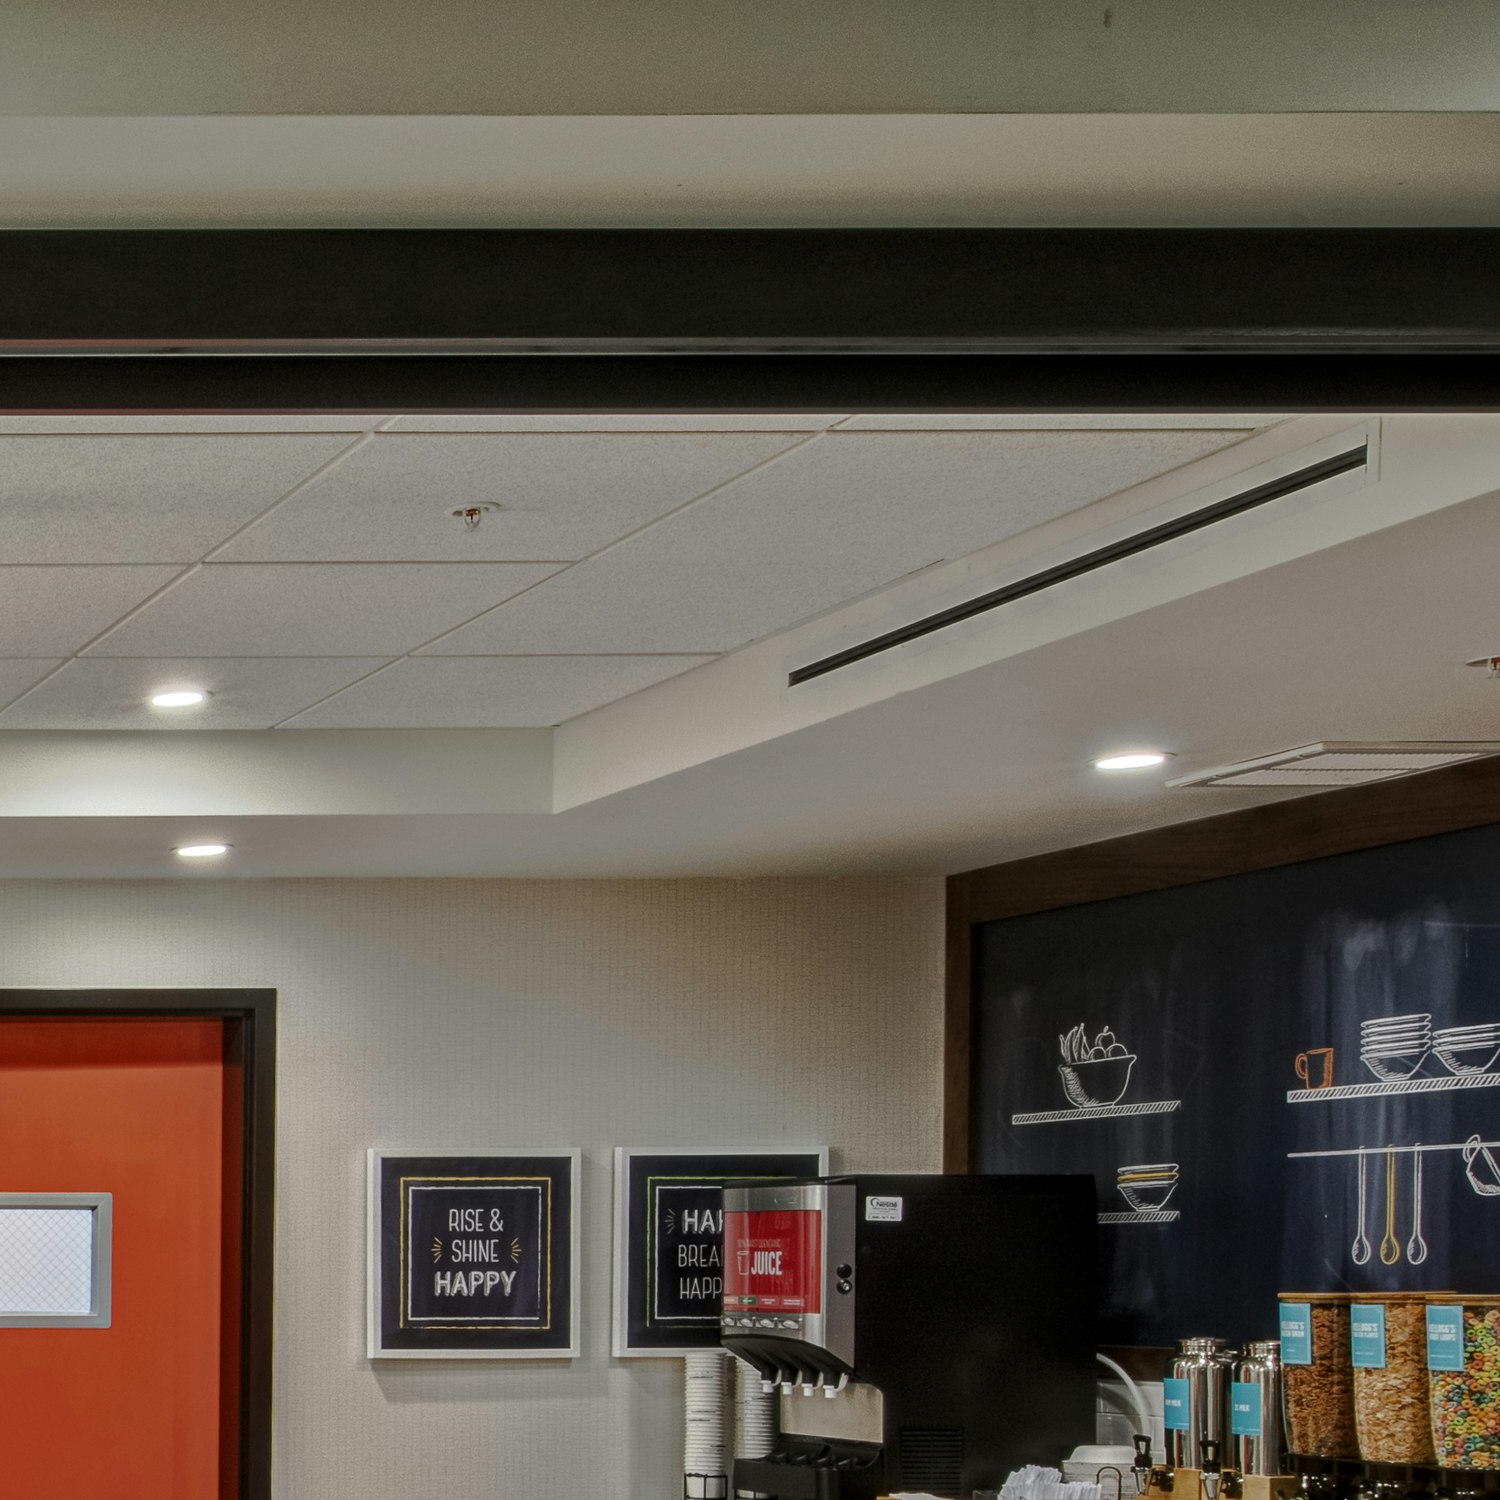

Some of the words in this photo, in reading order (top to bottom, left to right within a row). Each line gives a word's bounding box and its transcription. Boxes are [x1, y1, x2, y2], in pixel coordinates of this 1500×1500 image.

[448, 1208, 484, 1232] RISE
[489, 1208, 504, 1232] &
[451, 1239, 500, 1263] SHINE
[678, 1244, 724, 1267] BREA
[751, 1251, 782, 1275] JUICE
[434, 1270, 517, 1297] HAPPY
